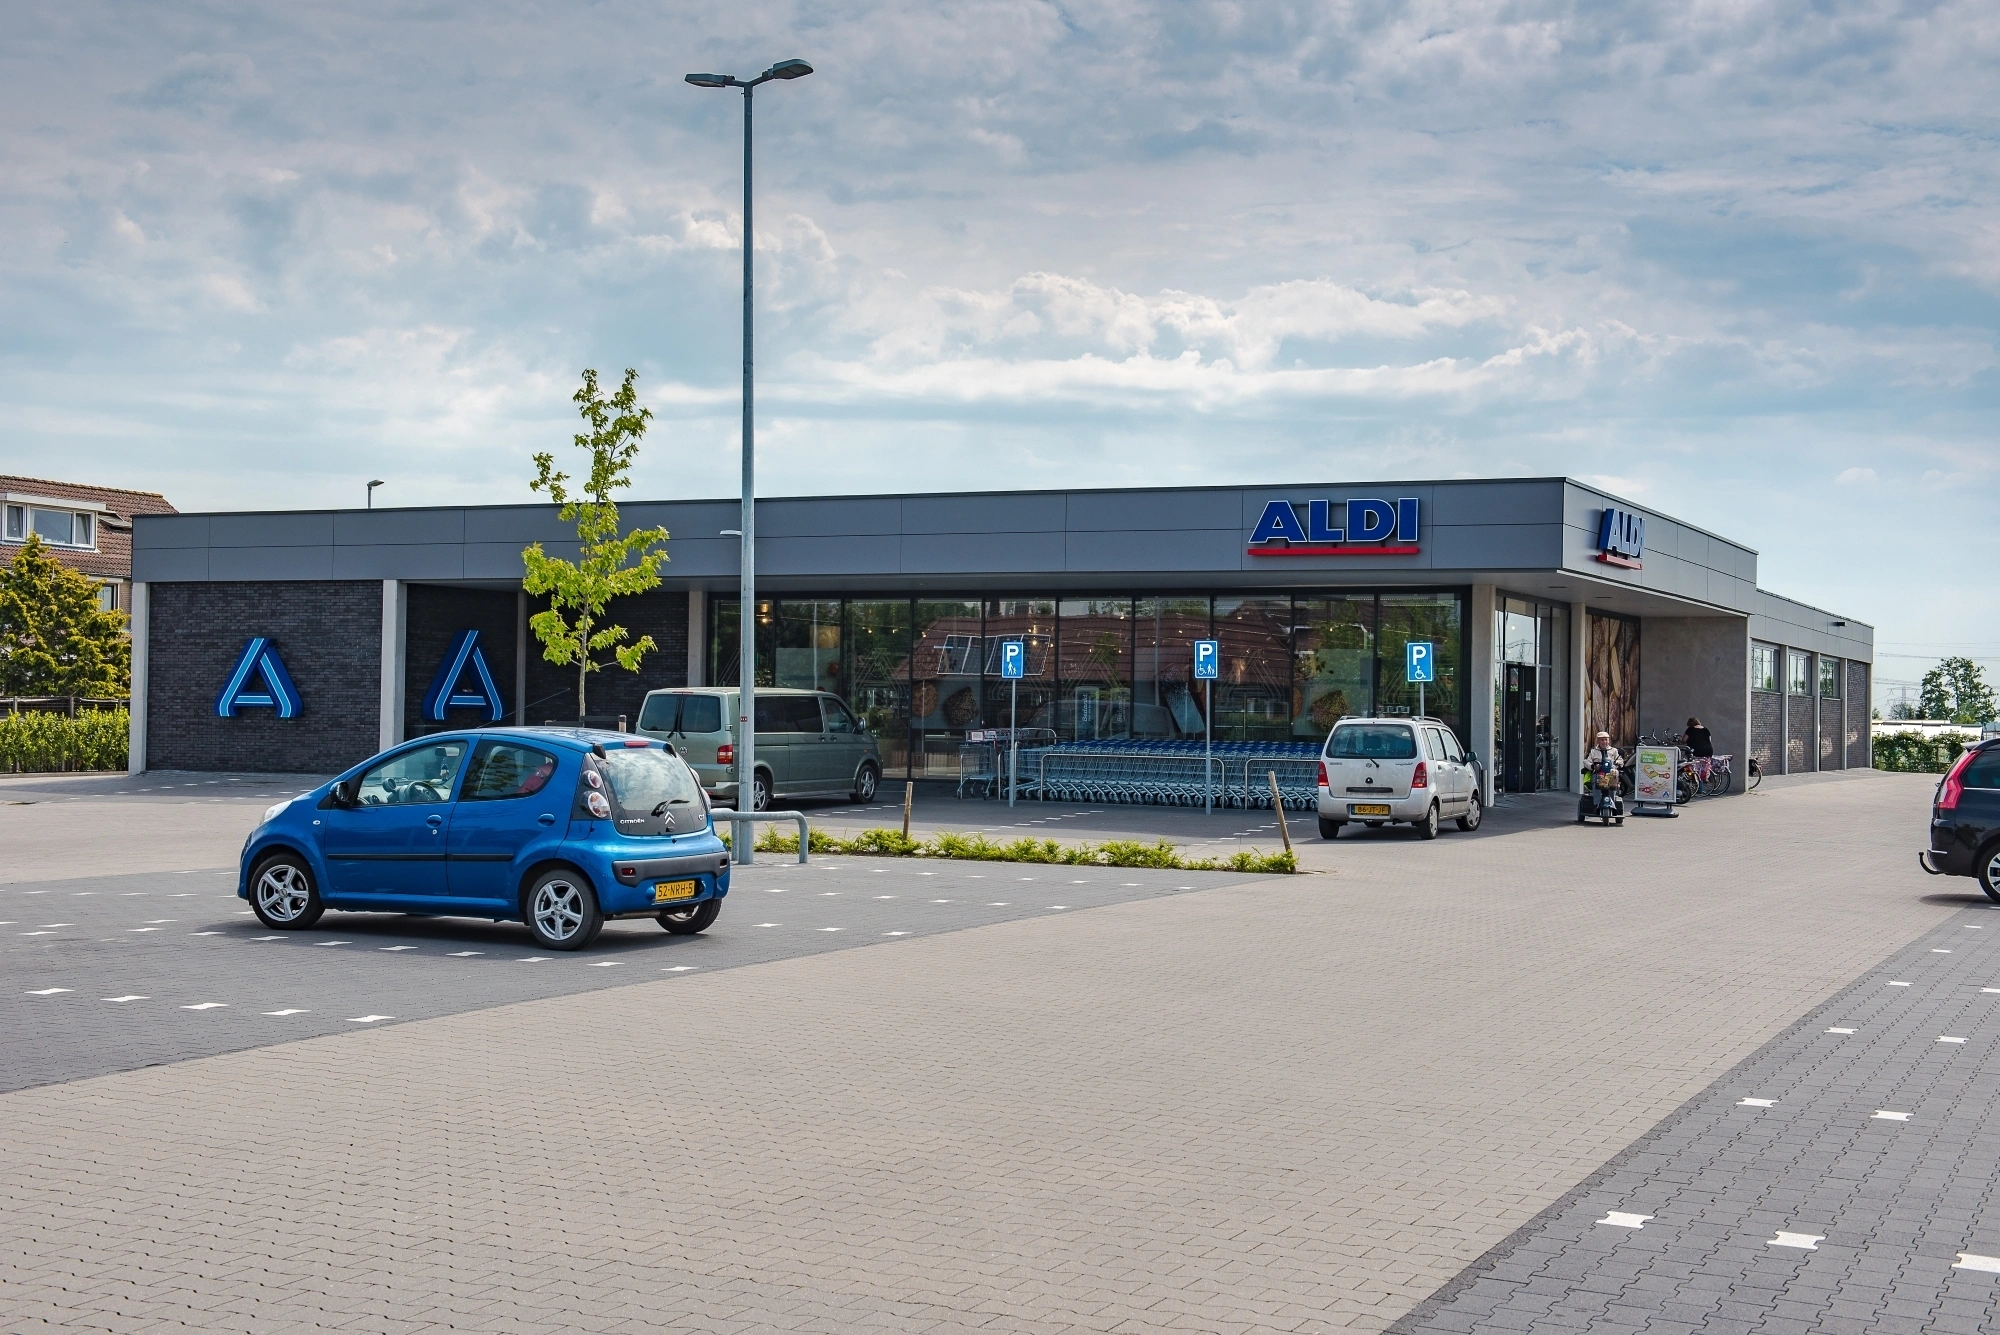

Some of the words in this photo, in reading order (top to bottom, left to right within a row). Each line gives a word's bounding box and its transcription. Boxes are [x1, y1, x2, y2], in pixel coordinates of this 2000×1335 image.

[1248, 498, 1419, 543] ALDI
[1604, 508, 1646, 559] ALDI
[1006, 647, 1019, 662] P
[1200, 643, 1213, 661] P
[1412, 645, 1427, 666] P
[658, 882, 693, 897] 52-NRH-5
